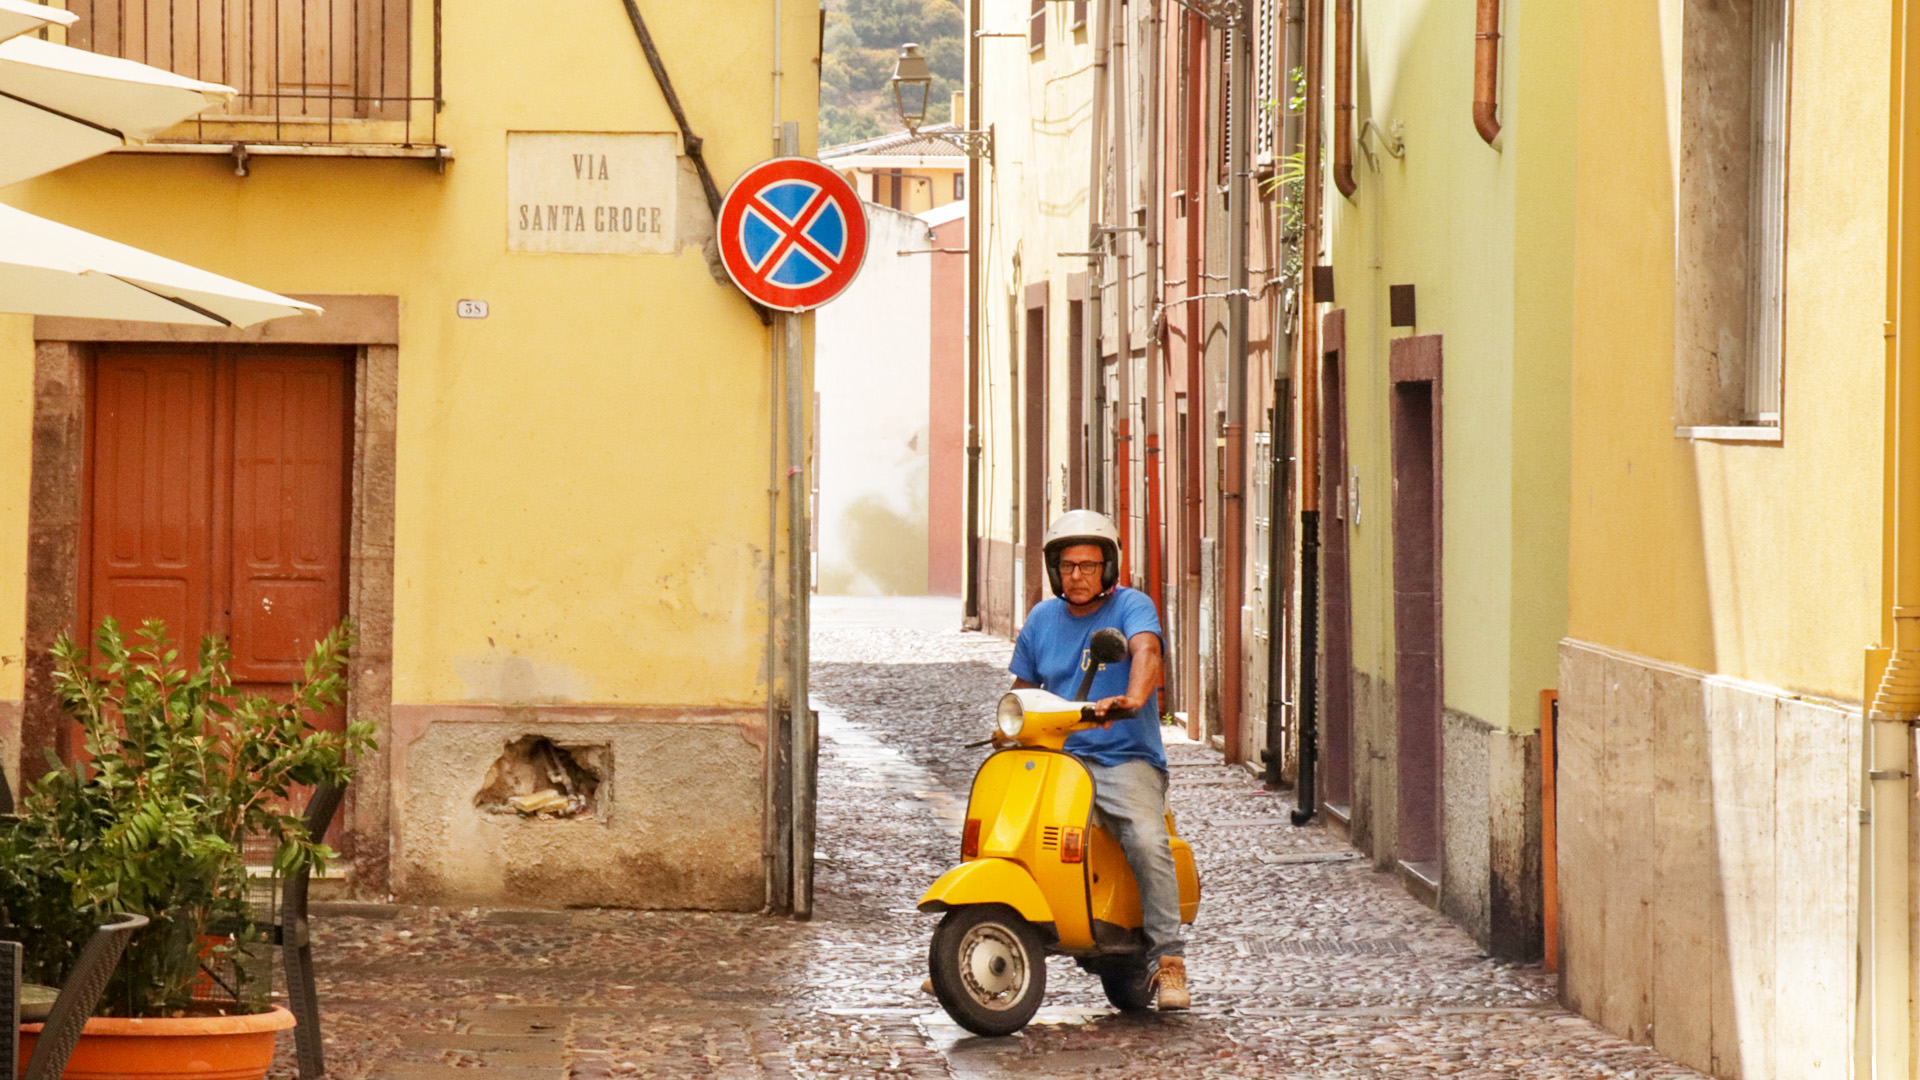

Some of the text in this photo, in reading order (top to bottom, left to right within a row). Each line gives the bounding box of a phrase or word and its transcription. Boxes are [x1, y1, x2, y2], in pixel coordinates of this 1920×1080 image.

[572, 154, 609, 180] VIA
[519, 204, 661, 233] SANTA CROCE
[465, 303, 481, 315] 38
